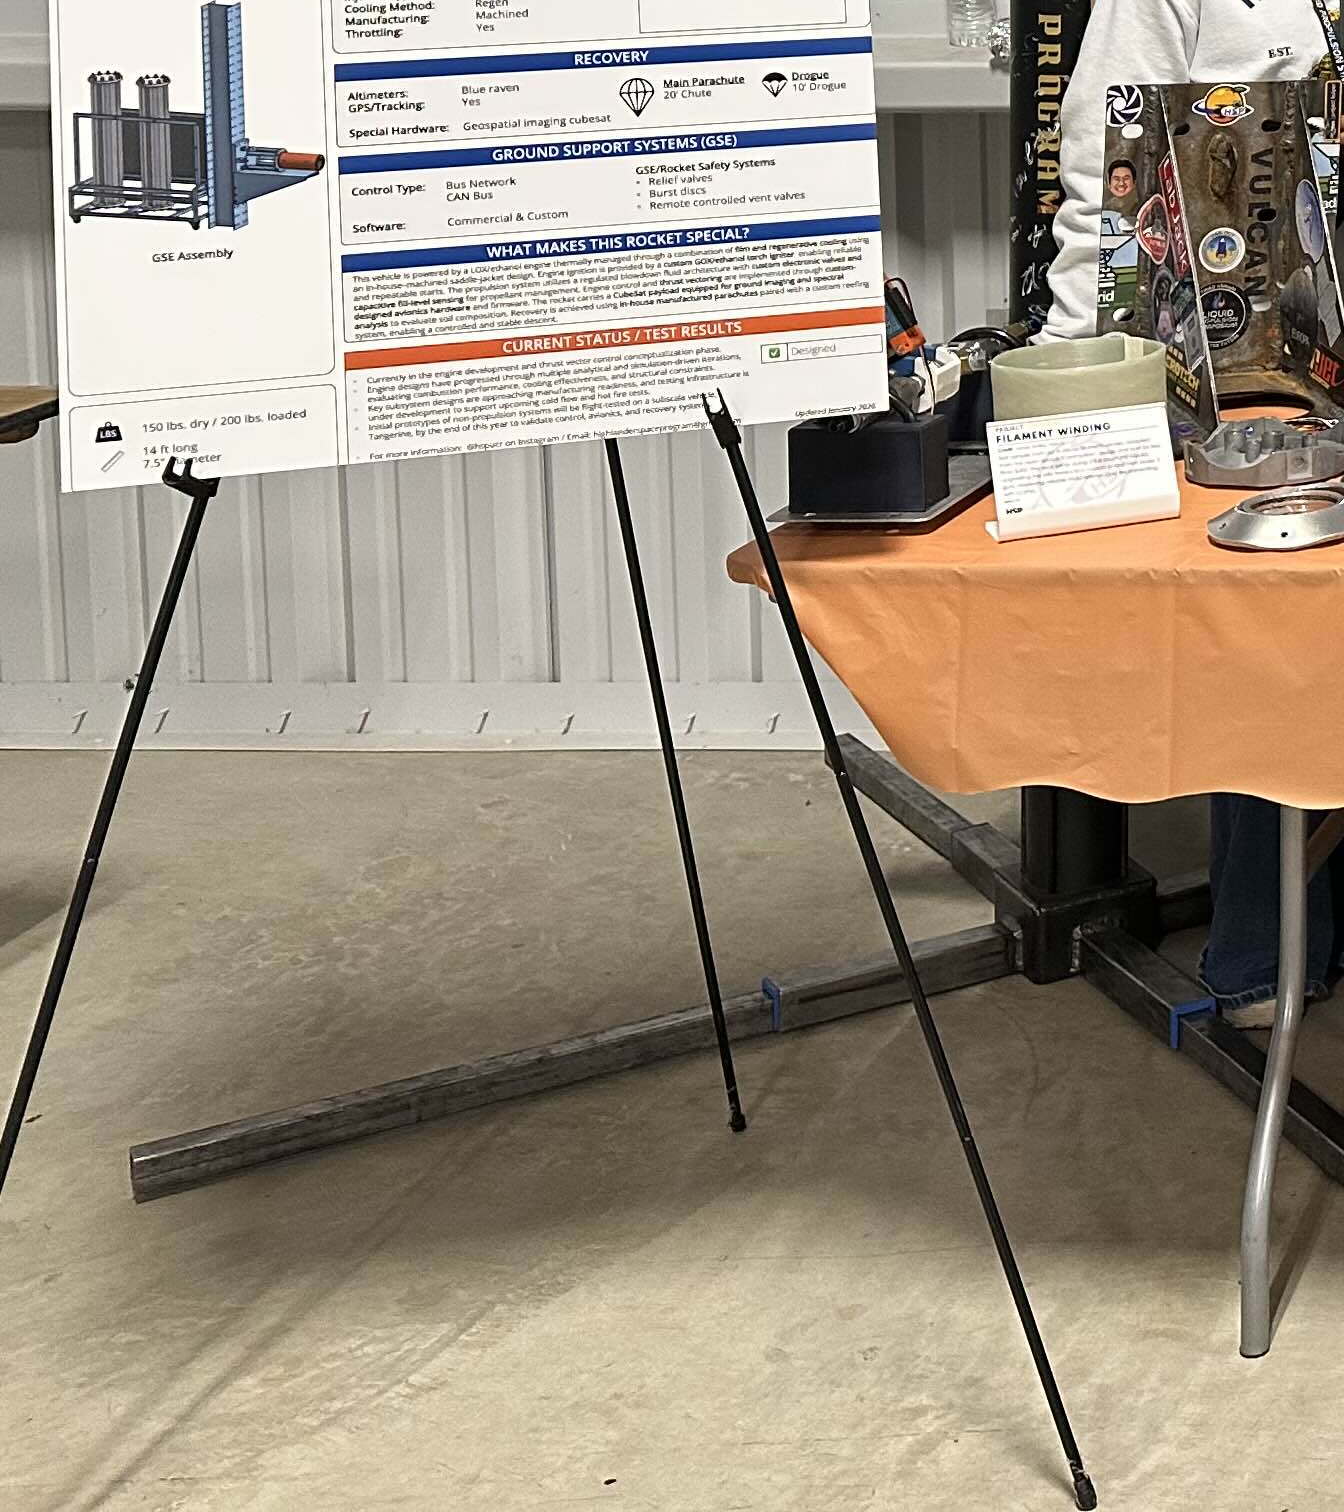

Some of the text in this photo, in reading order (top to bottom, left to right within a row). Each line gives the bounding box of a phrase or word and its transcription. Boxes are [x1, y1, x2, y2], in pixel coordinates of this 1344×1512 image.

[574, 50, 648, 65] RECOVERY
[1267, 46, 1294, 59] EST.
[1036, 13, 1064, 215] PROGRAM
[349, 125, 448, 139] Special Hardware:
[492, 134, 737, 160] GROUND SUPPORT SYSTEMS (GSE)
[351, 184, 425, 196] Control Type:
[1243, 146, 1276, 298] VULCAN
[486, 224, 749, 257] WHAT MAKES THIS ROCKET SPECIAL?
[152, 248, 233, 262] GSE Assembly
[502, 321, 742, 353] CURRENT STATUS / TEST RESULTS
[996, 422, 1111, 444] FILAMENT WINDING
